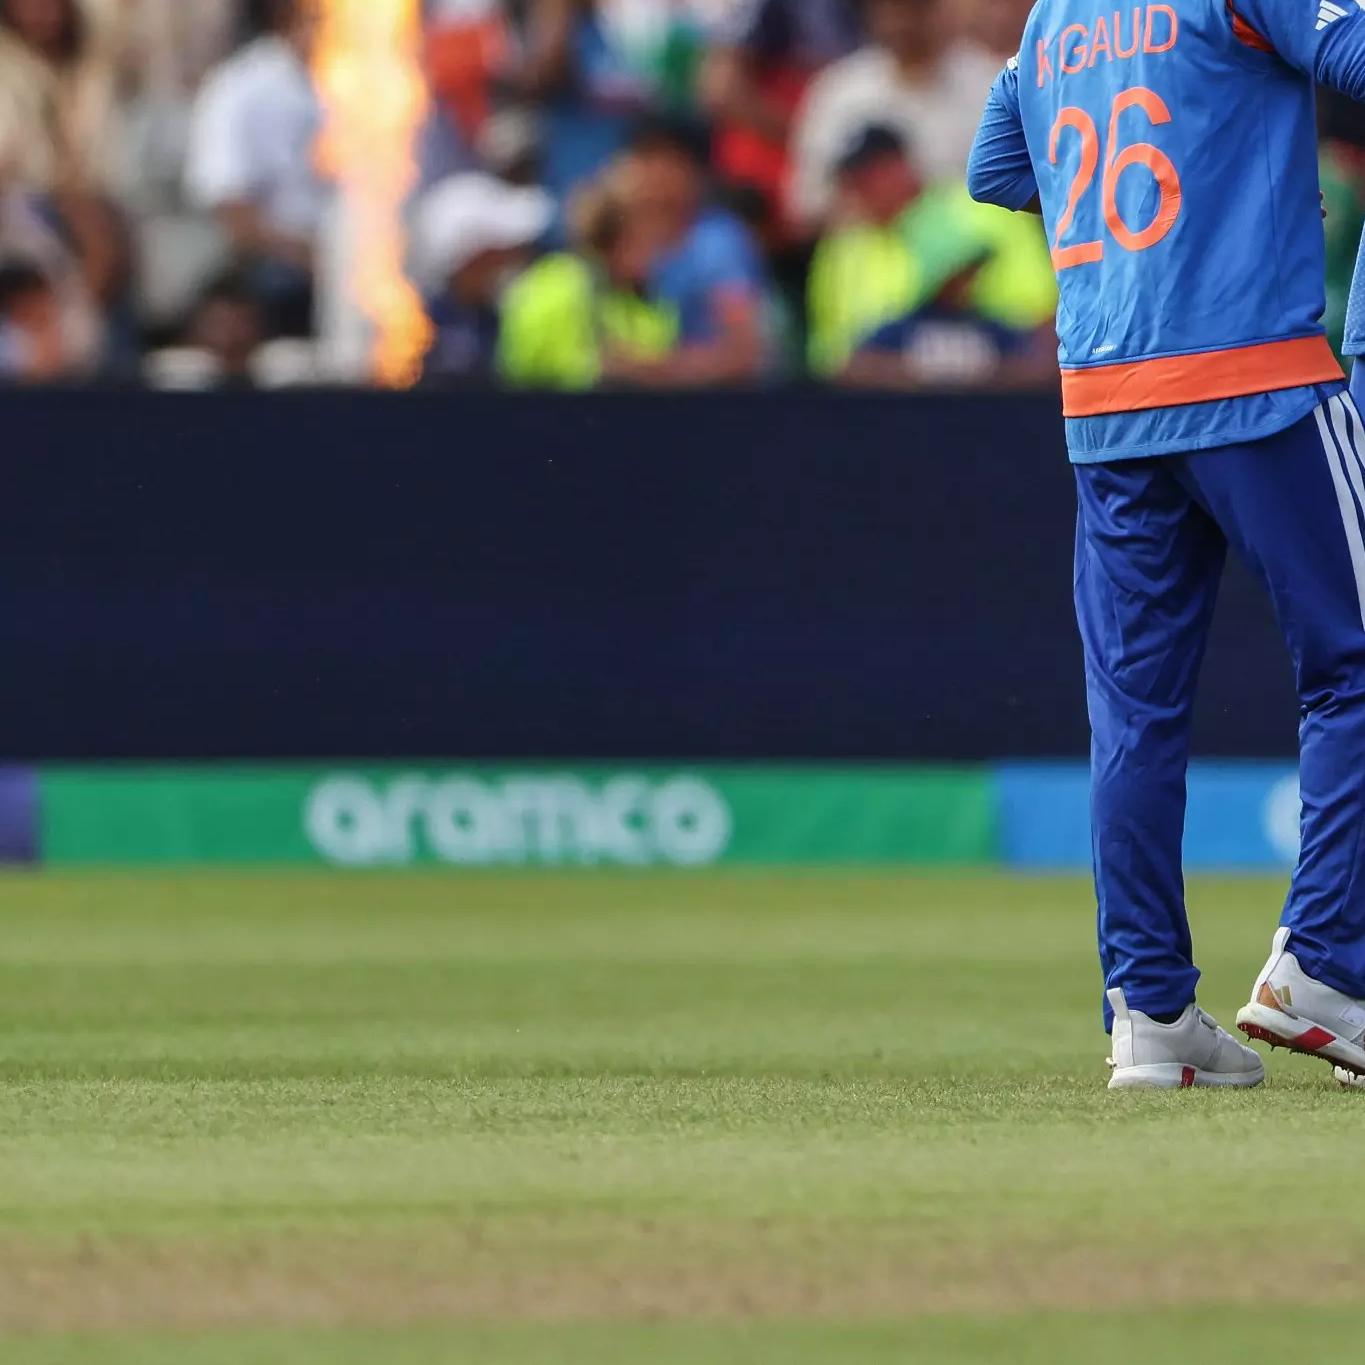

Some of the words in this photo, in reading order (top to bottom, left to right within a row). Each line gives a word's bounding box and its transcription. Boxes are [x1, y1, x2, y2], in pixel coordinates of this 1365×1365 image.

[1059, 4, 1179, 75] GAUD
[1048, 86, 1182, 273] 26
[305, 770, 733, 867] aramco
